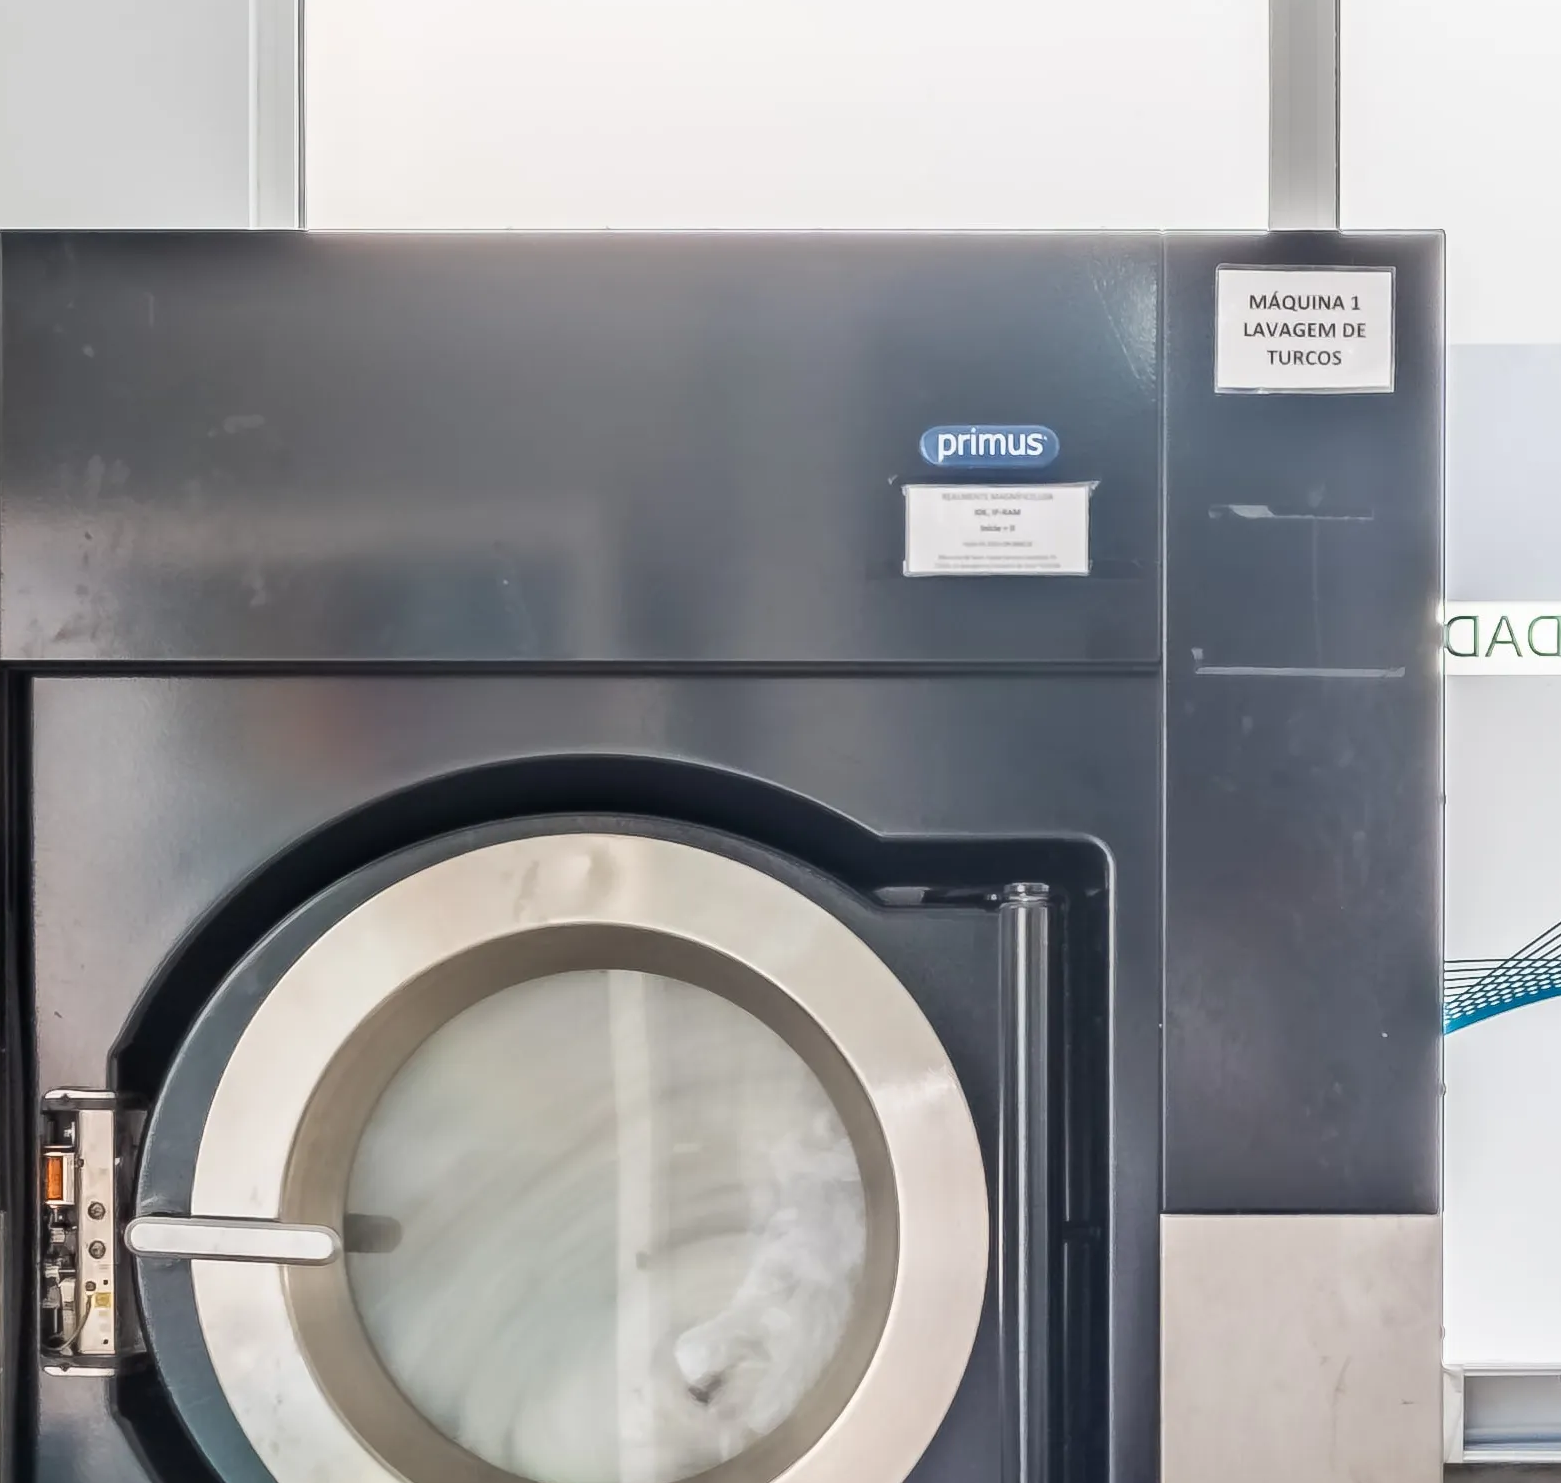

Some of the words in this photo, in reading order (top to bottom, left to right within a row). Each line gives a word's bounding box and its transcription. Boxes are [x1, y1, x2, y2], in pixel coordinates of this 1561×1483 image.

[1248, 291, 1345, 312] MÁQUINA
[1350, 295, 1361, 311] 1
[1243, 322, 1337, 338] LAVAGEM
[1342, 323, 1367, 338] DE
[1266, 350, 1343, 366] TURCOS
[938, 426, 1045, 464] primus
